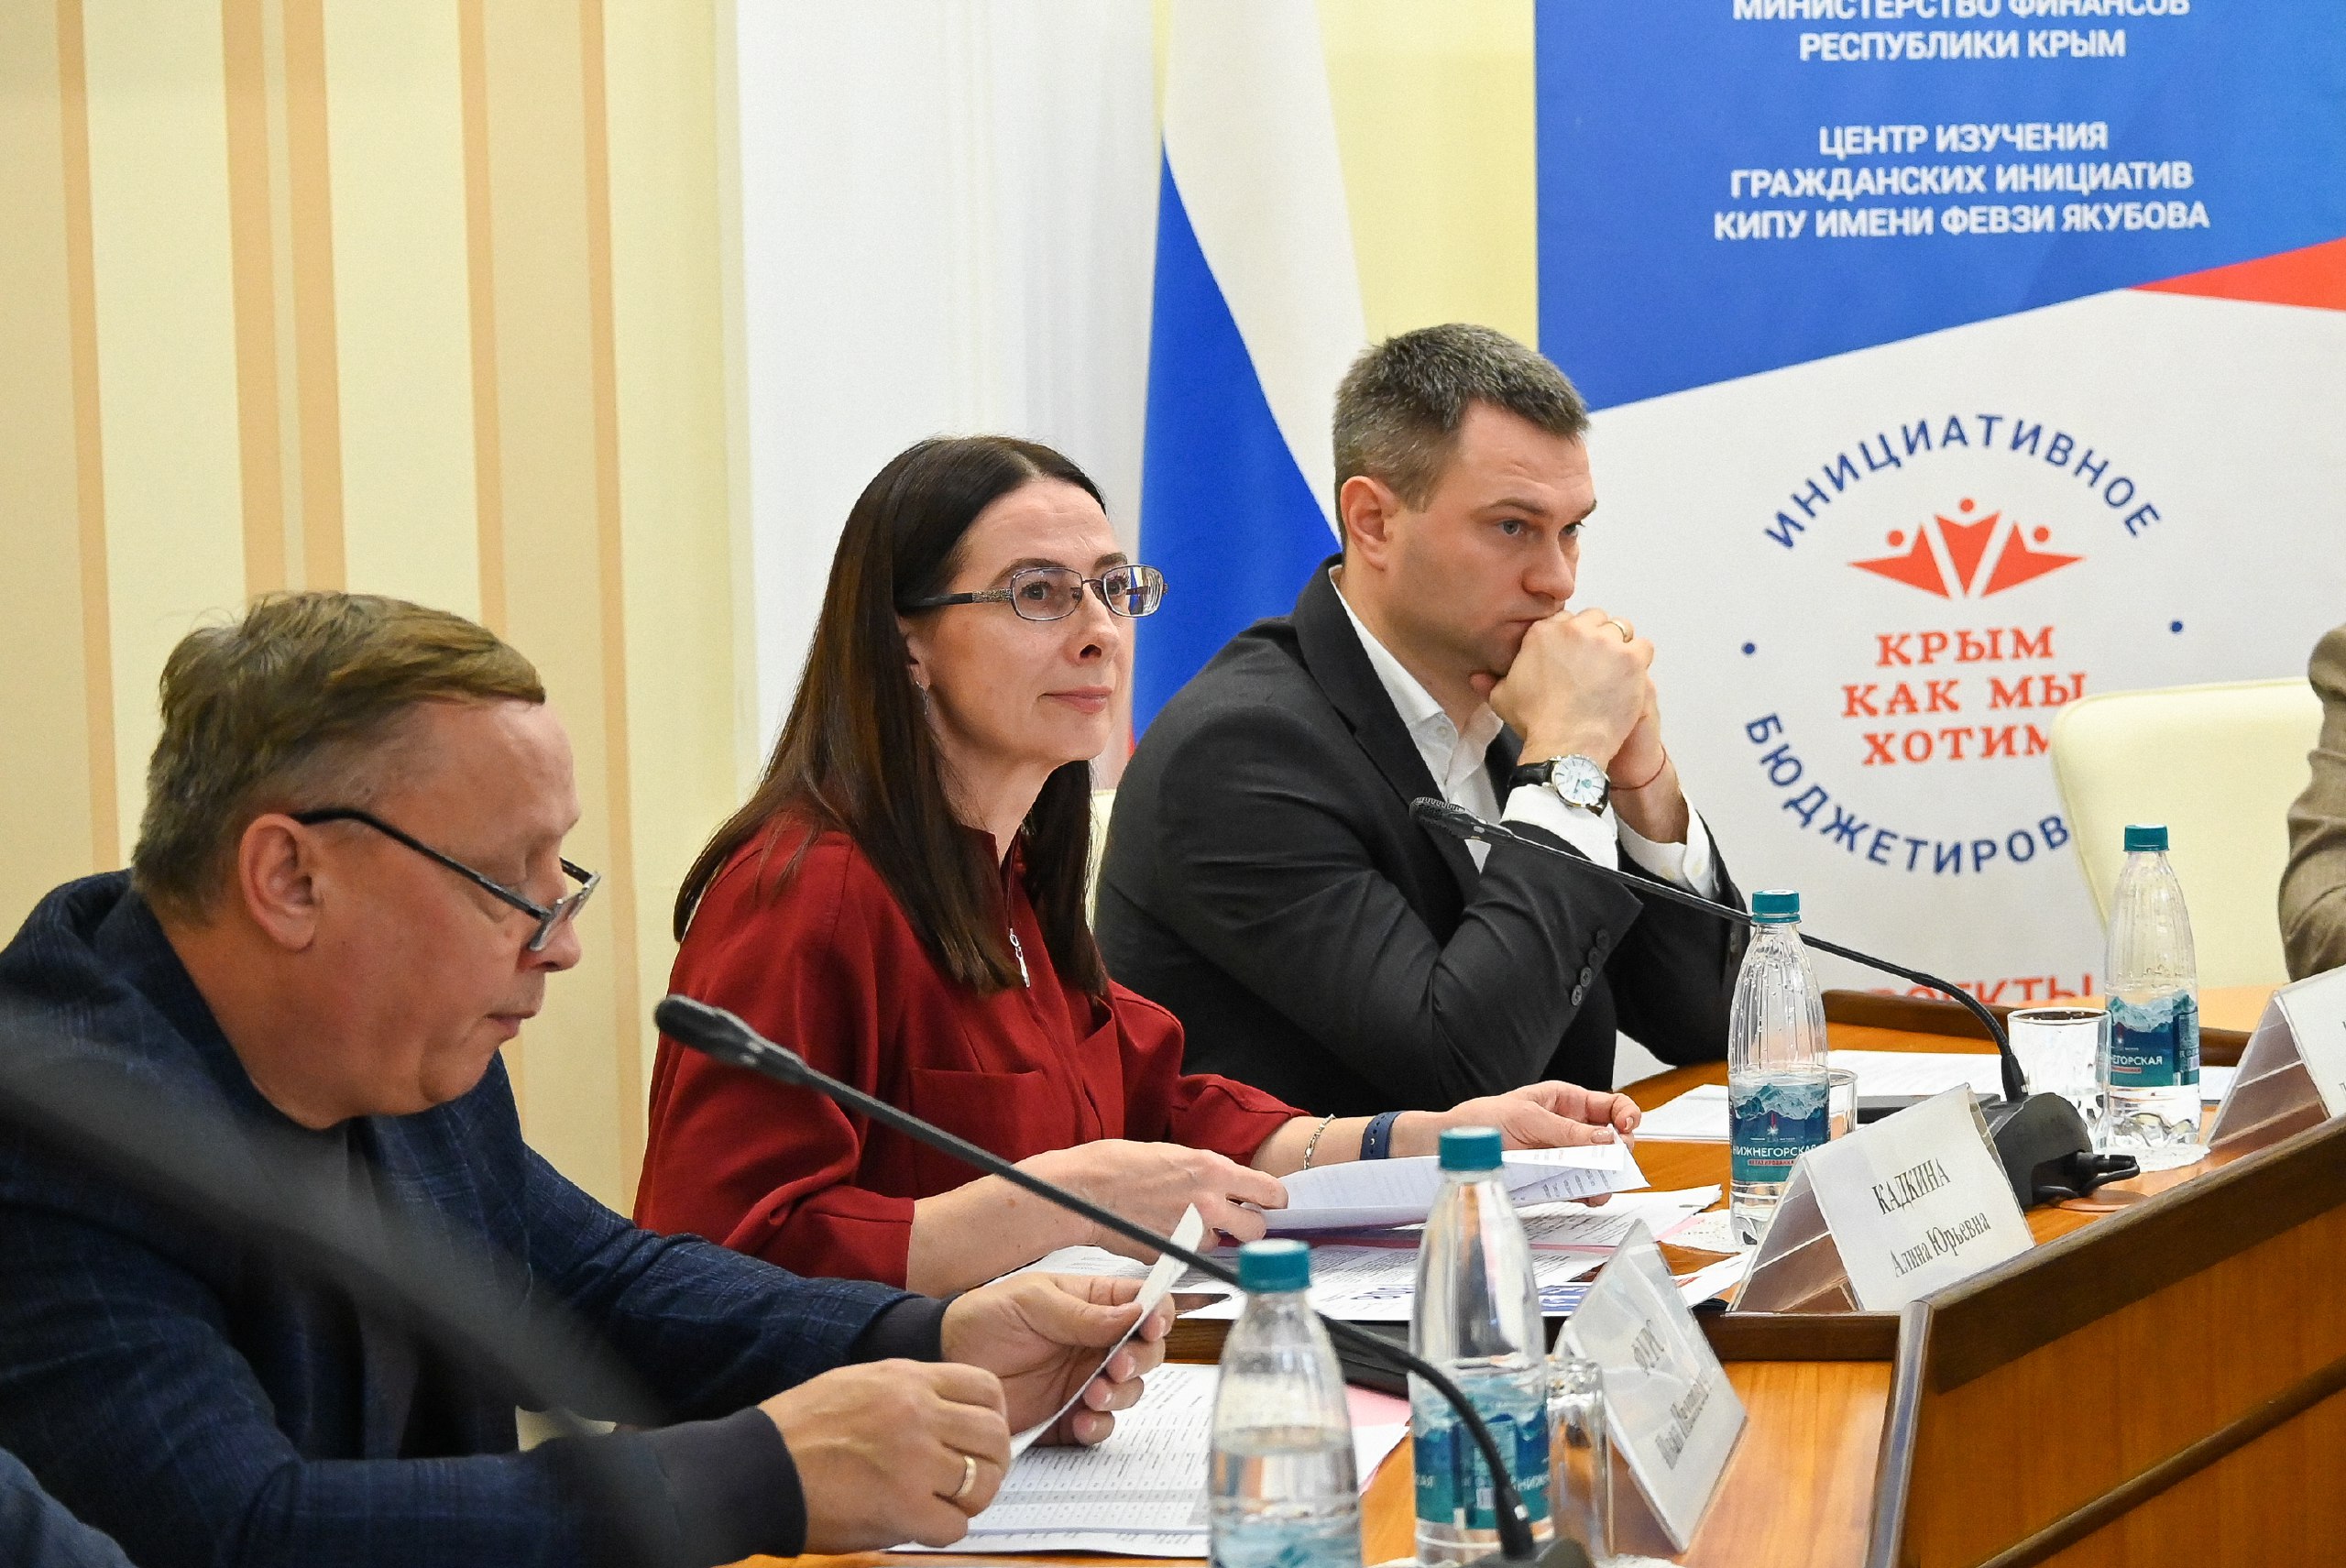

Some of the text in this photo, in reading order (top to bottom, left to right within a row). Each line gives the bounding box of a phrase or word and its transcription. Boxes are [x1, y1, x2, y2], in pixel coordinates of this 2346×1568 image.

[1732, 0, 2191, 19] МИНИСТЕРСТВО ФИНАНСОВ
[1799, 28, 2126, 60] РЕСПУБЛИКИ КРЫМ
[1819, 120, 2108, 161] ЦЕНТР ИЗУЧЕНИЯ
[1730, 159, 2195, 202] ГРАЖДАНСКИХ ИНИЦИАТИВ
[1714, 200, 2211, 240] КИПУ ИМЕНИ ФЕВЗИ ЯКУБОВА
[1763, 413, 2162, 549] ИНИЦИАТИВНОЕ
[1875, 625, 2055, 667] КРЫМ
[1841, 670, 2088, 718] КАК МЫ
[1861, 723, 2050, 766] ХОТИМ
[1745, 712, 2070, 874] БЮДЖЕТИРОВ
[1871, 1158, 1951, 1215] КАДКИНА
[1890, 1212, 1991, 1277] Алина Юрьевна
